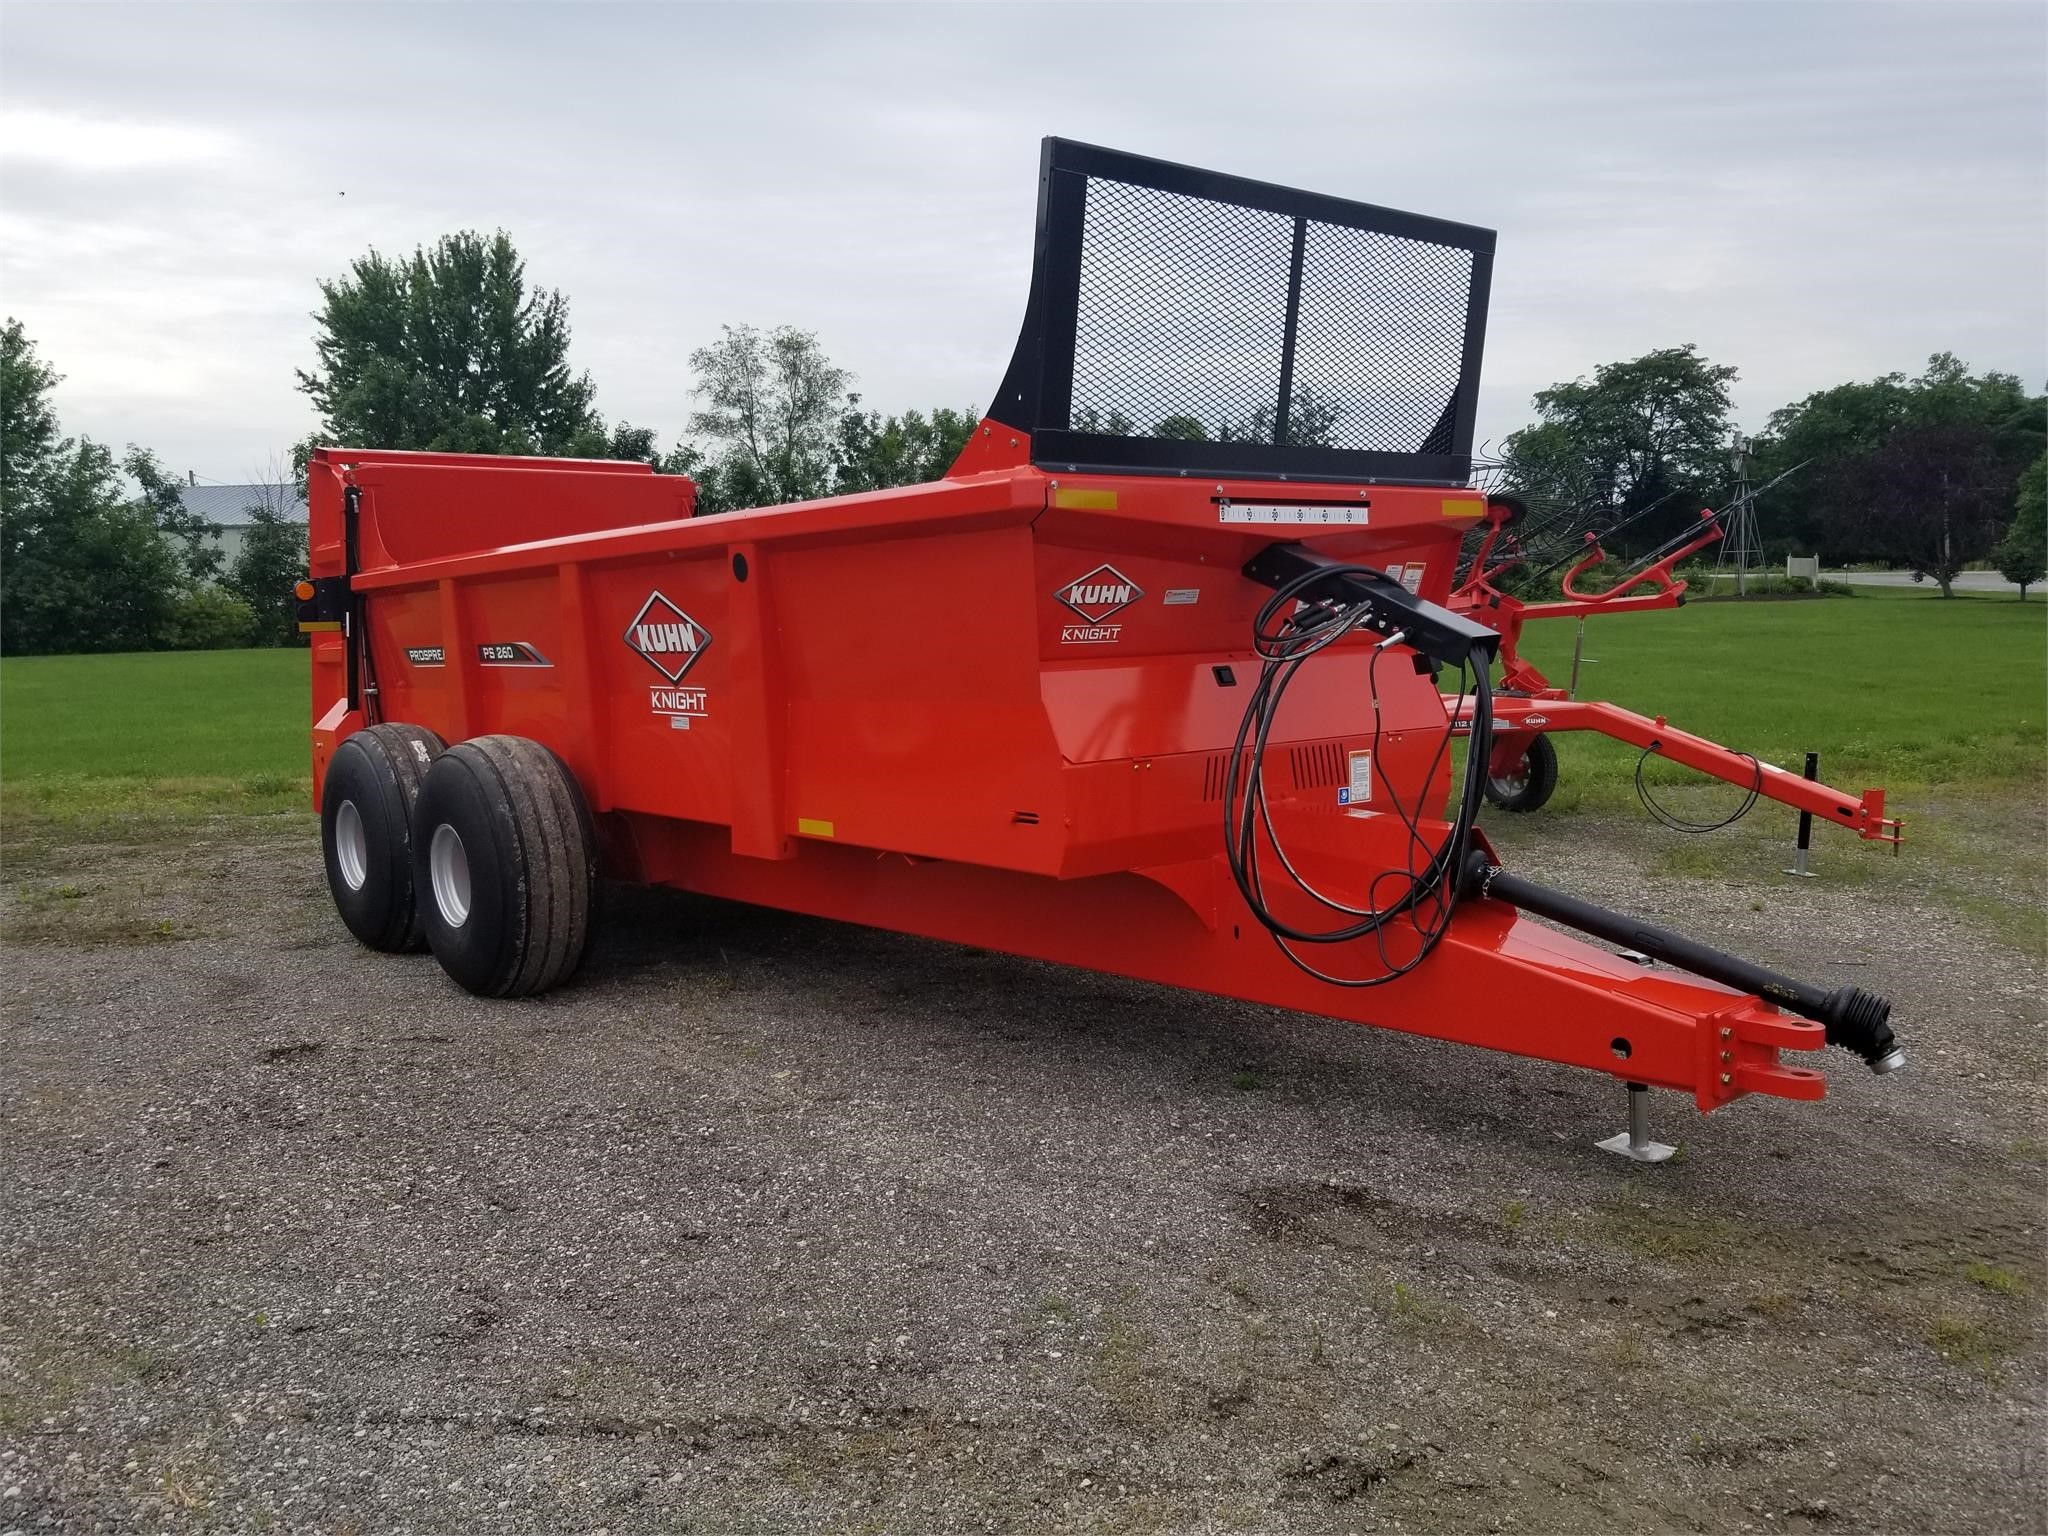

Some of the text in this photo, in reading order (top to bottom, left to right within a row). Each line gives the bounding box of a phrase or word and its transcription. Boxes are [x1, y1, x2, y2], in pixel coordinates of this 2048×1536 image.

[1272, 511, 1278, 519] 20
[1297, 511, 1303, 519] 30
[1346, 512, 1352, 520] 50
[1070, 585, 1131, 604] KUHN
[637, 623, 697, 652] KUHN
[1061, 627, 1121, 640] KNIGHT
[483, 646, 513, 659] PS 260
[651, 691, 707, 711] KNIGHT
